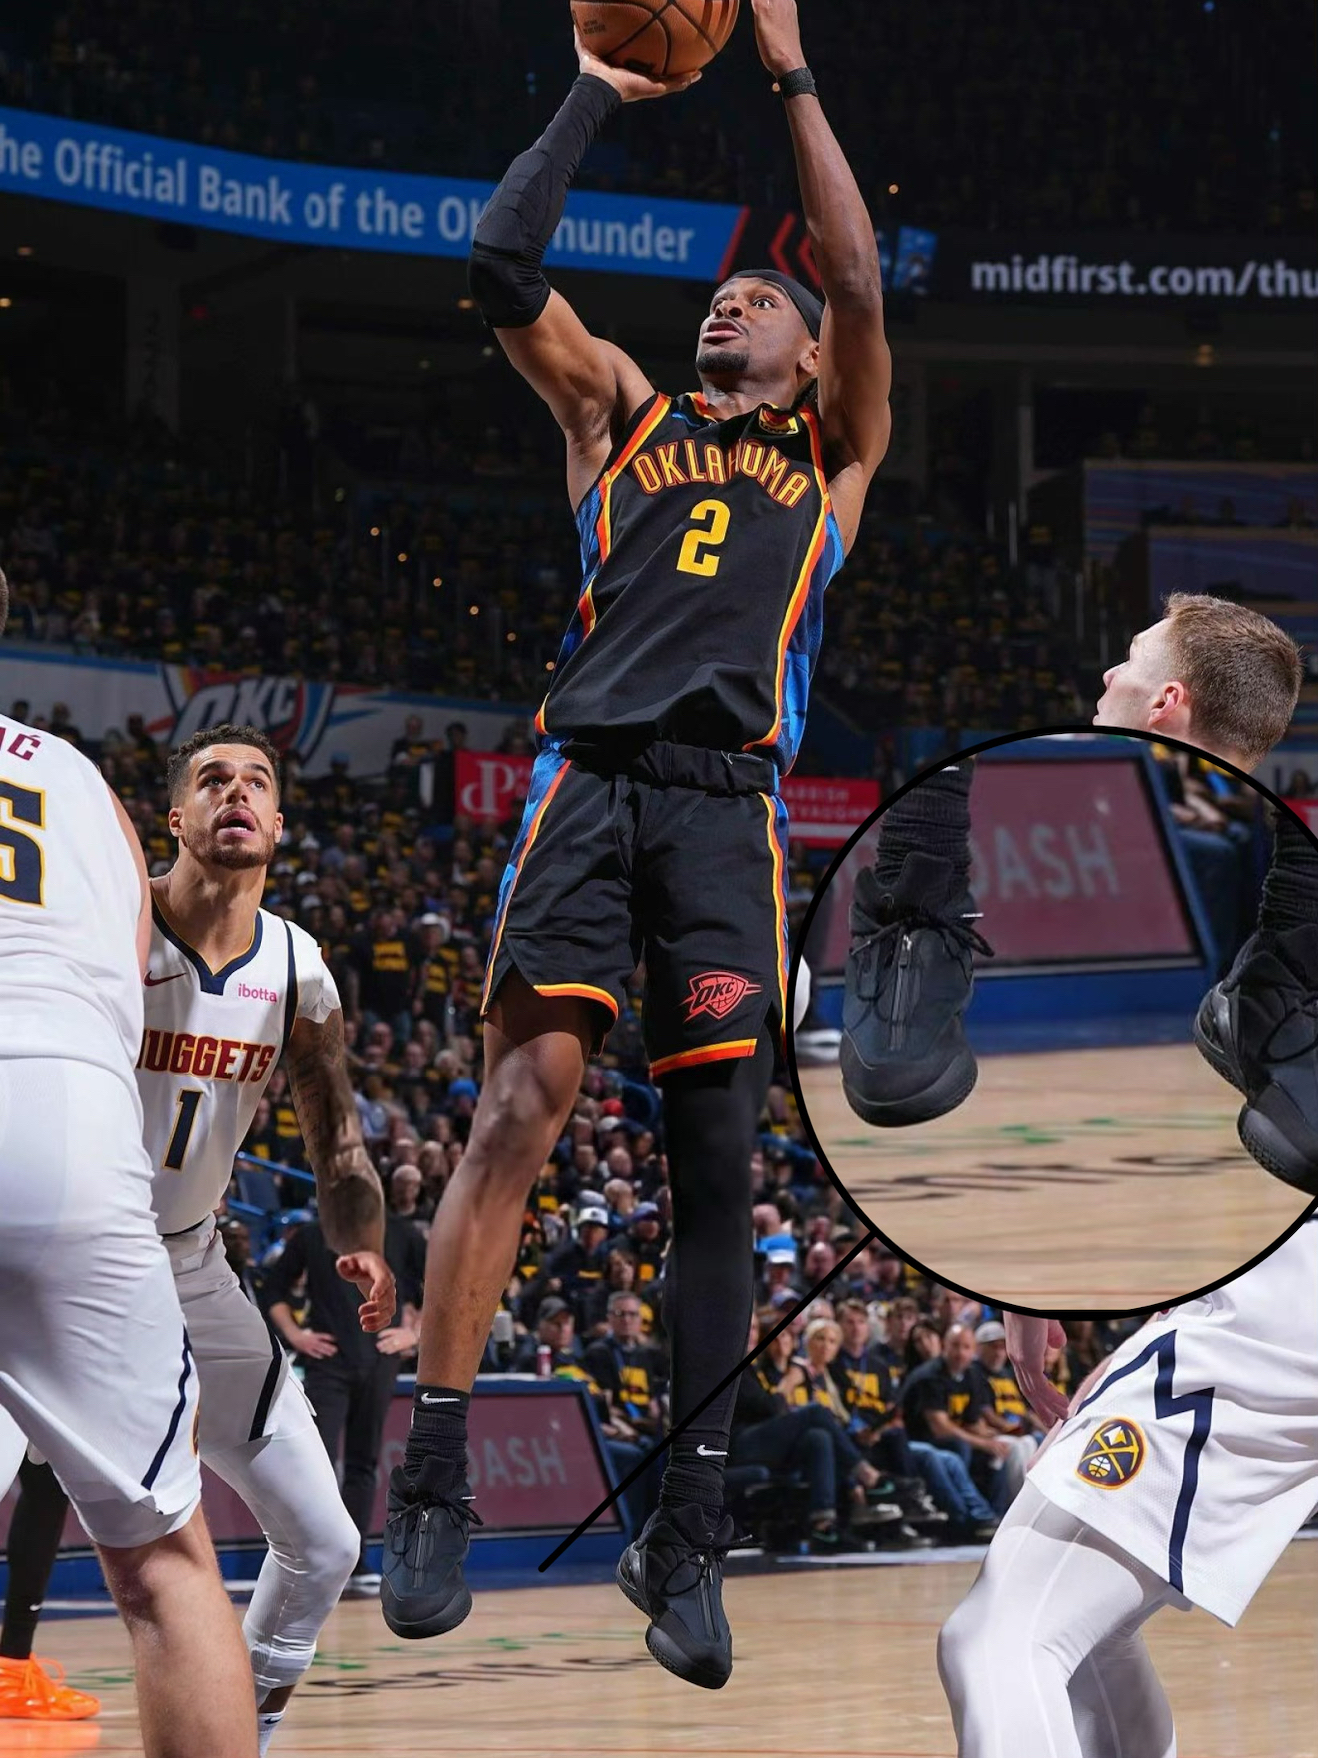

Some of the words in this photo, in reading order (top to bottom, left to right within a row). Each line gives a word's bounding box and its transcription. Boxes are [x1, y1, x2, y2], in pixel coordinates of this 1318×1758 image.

[54, 138, 187, 207] Official
[199, 165, 291, 226] Bank
[304, 183, 346, 231] of
[356, 187, 424, 238] the
[632, 438, 811, 509] OKLAHOMA
[676, 499, 731, 577] 2
[237, 983, 278, 1003] ibotta
[690, 981, 736, 1011] OKC
[162, 1088, 204, 1174] 1
